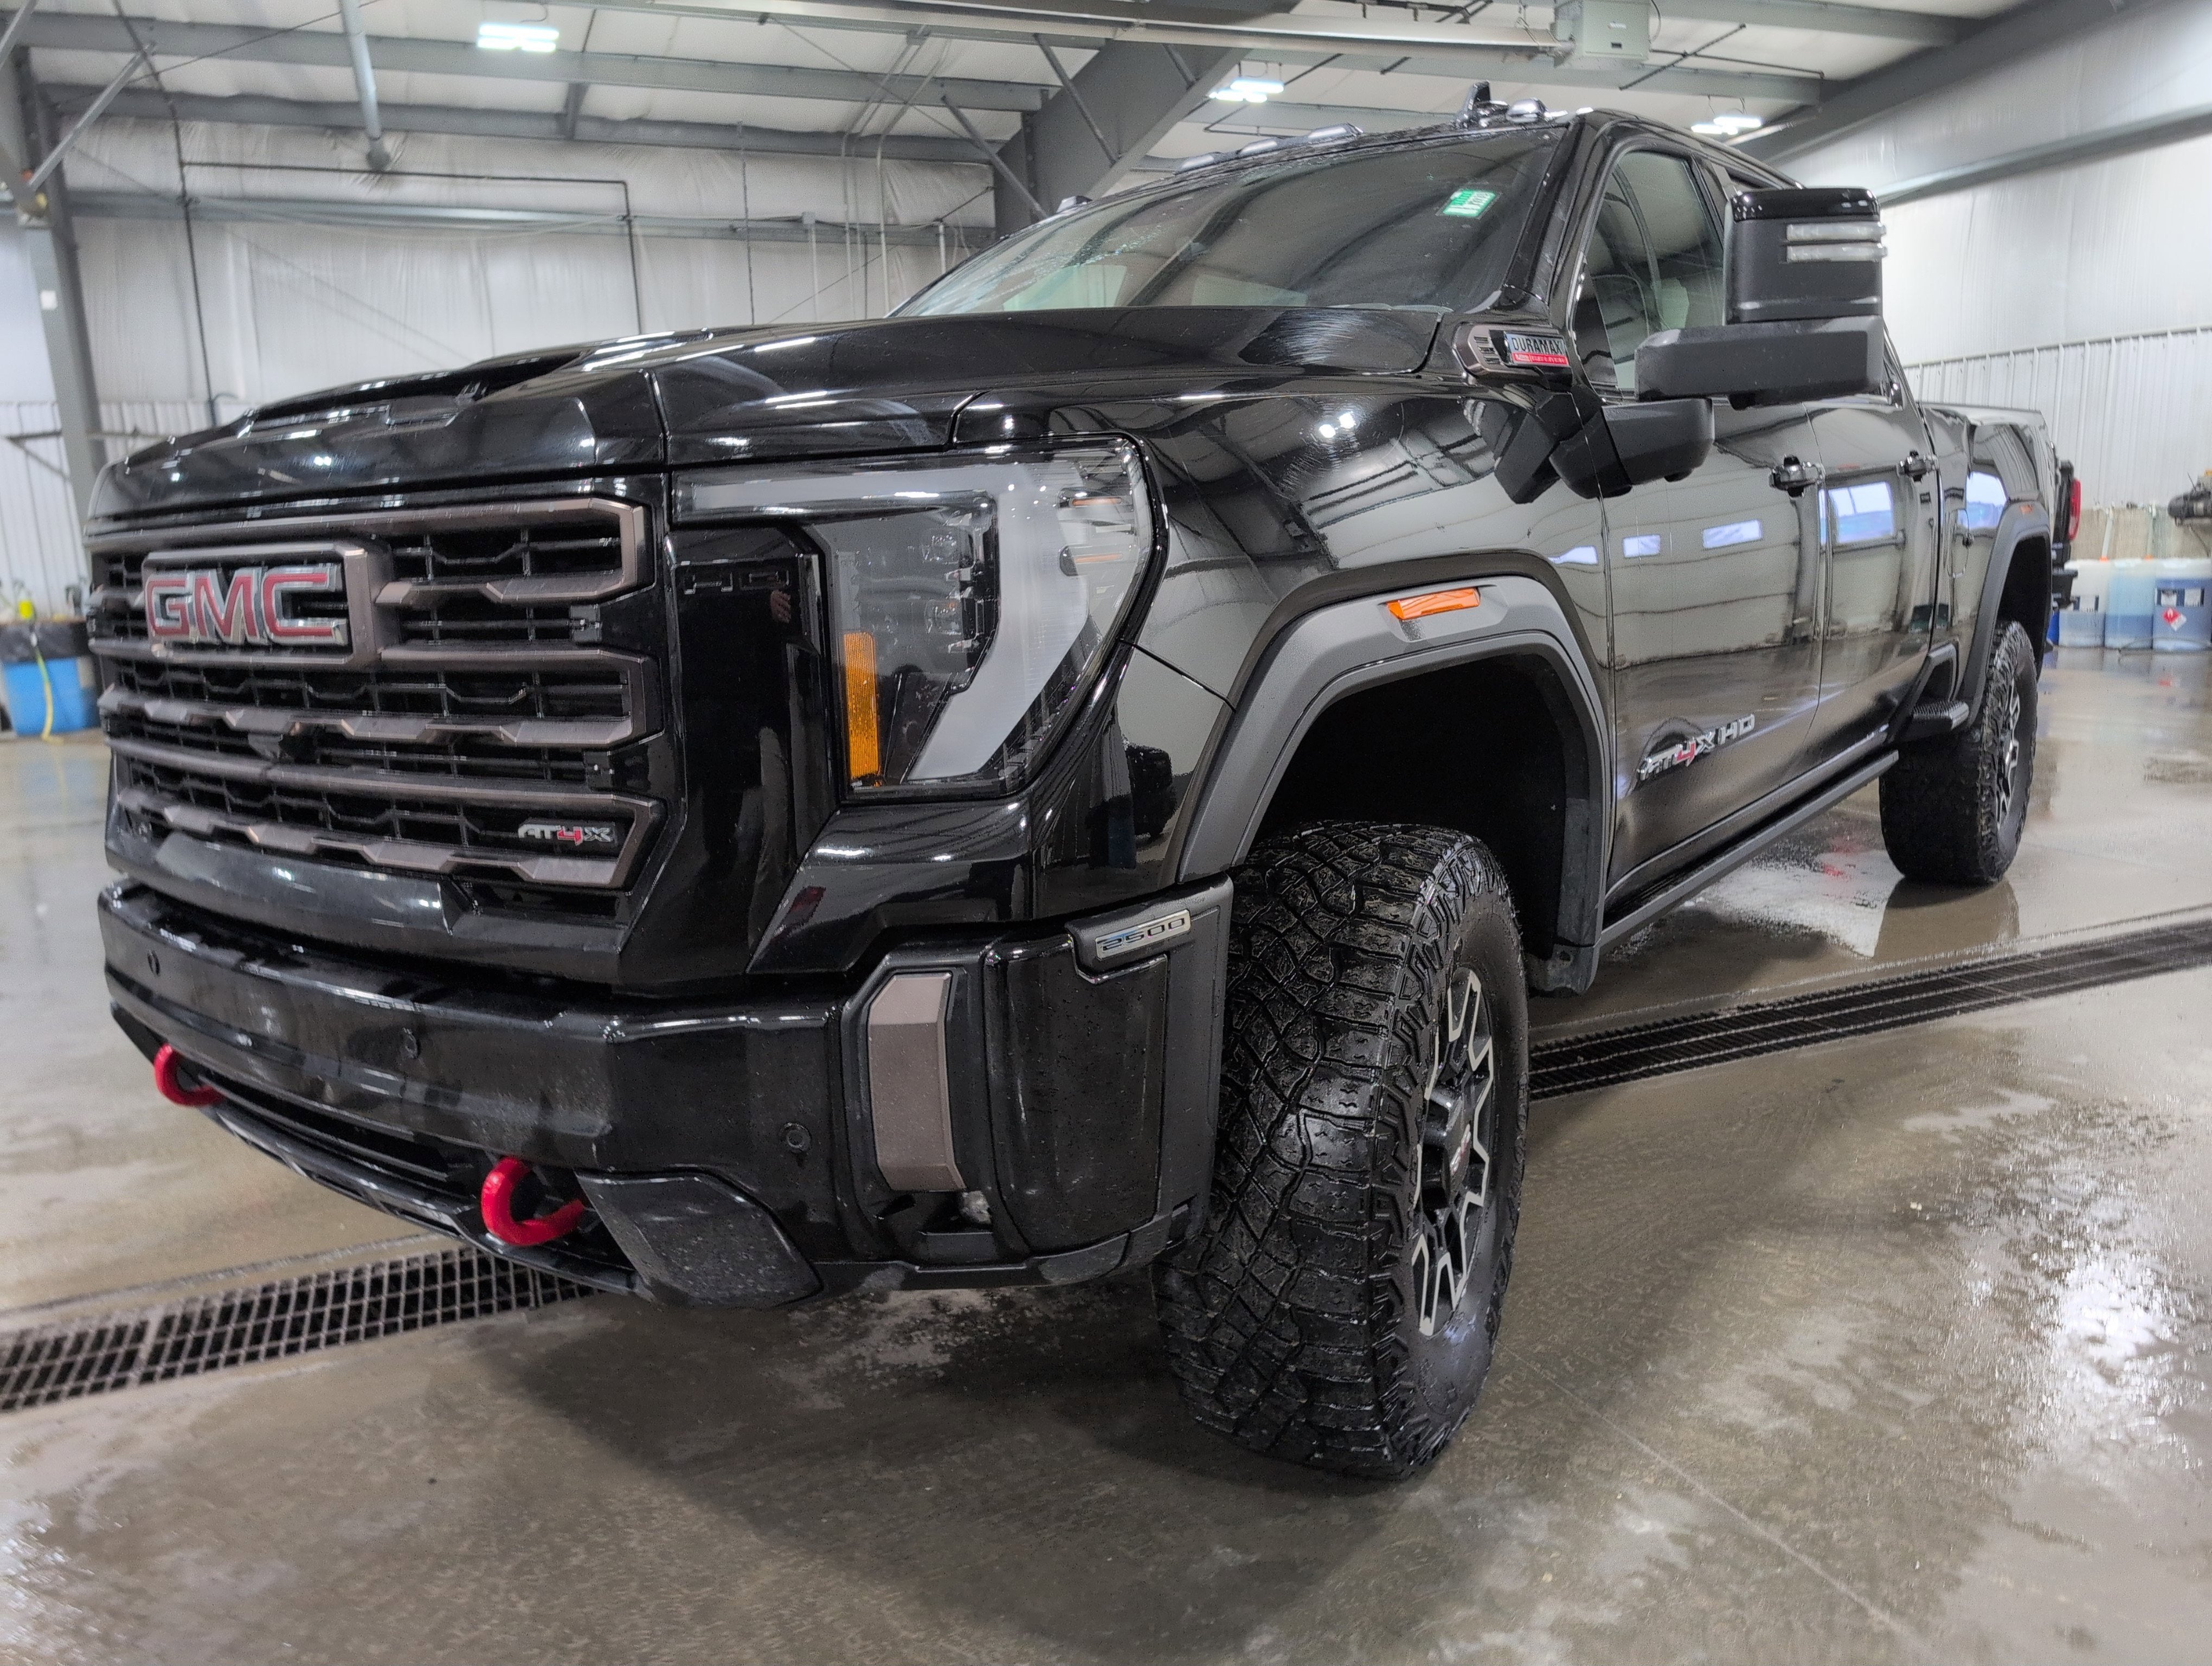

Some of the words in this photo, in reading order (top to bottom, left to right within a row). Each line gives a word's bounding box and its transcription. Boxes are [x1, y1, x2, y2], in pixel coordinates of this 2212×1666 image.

[1511, 337, 1564, 355] DURAMAX
[145, 563, 348, 645] GMC
[1716, 714, 1755, 745] HD
[518, 823, 612, 846] AT4X
[1098, 918, 1185, 951] 2500
